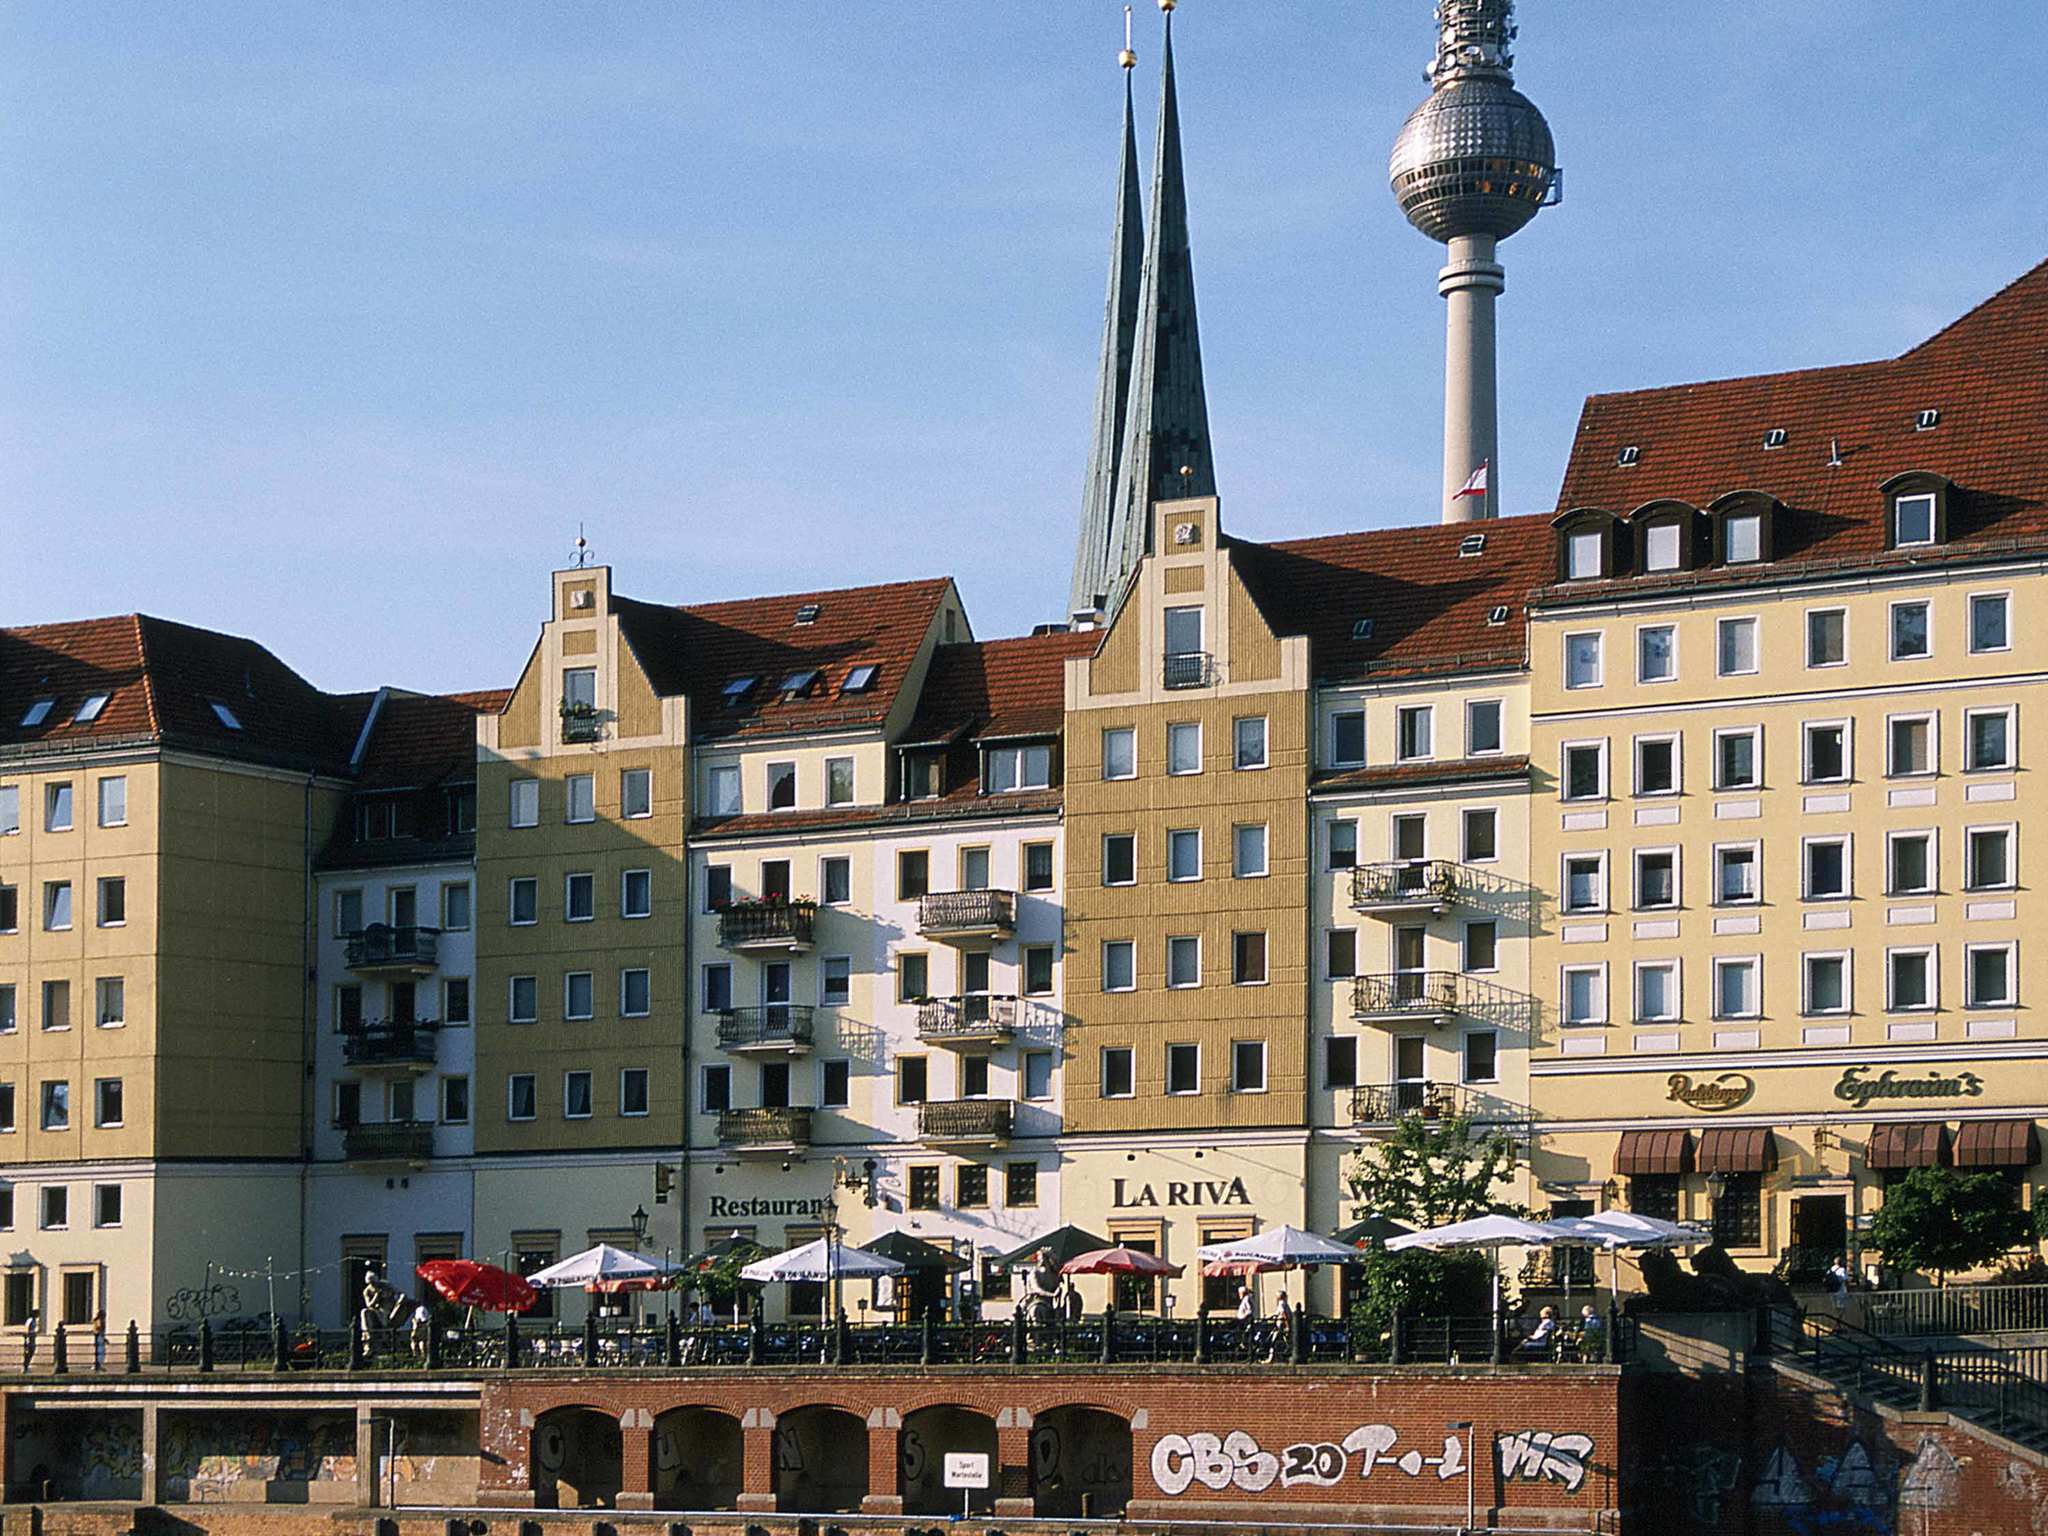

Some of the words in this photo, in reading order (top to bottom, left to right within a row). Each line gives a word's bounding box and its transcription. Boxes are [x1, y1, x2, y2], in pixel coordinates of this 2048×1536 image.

[1834, 1066, 1984, 1108] Ephraim's
[710, 1195, 823, 1218] Restauran
[1112, 1178, 1159, 1208] LA
[1168, 1175, 1254, 1207] RIVA
[1151, 1430, 1280, 1496] CBS
